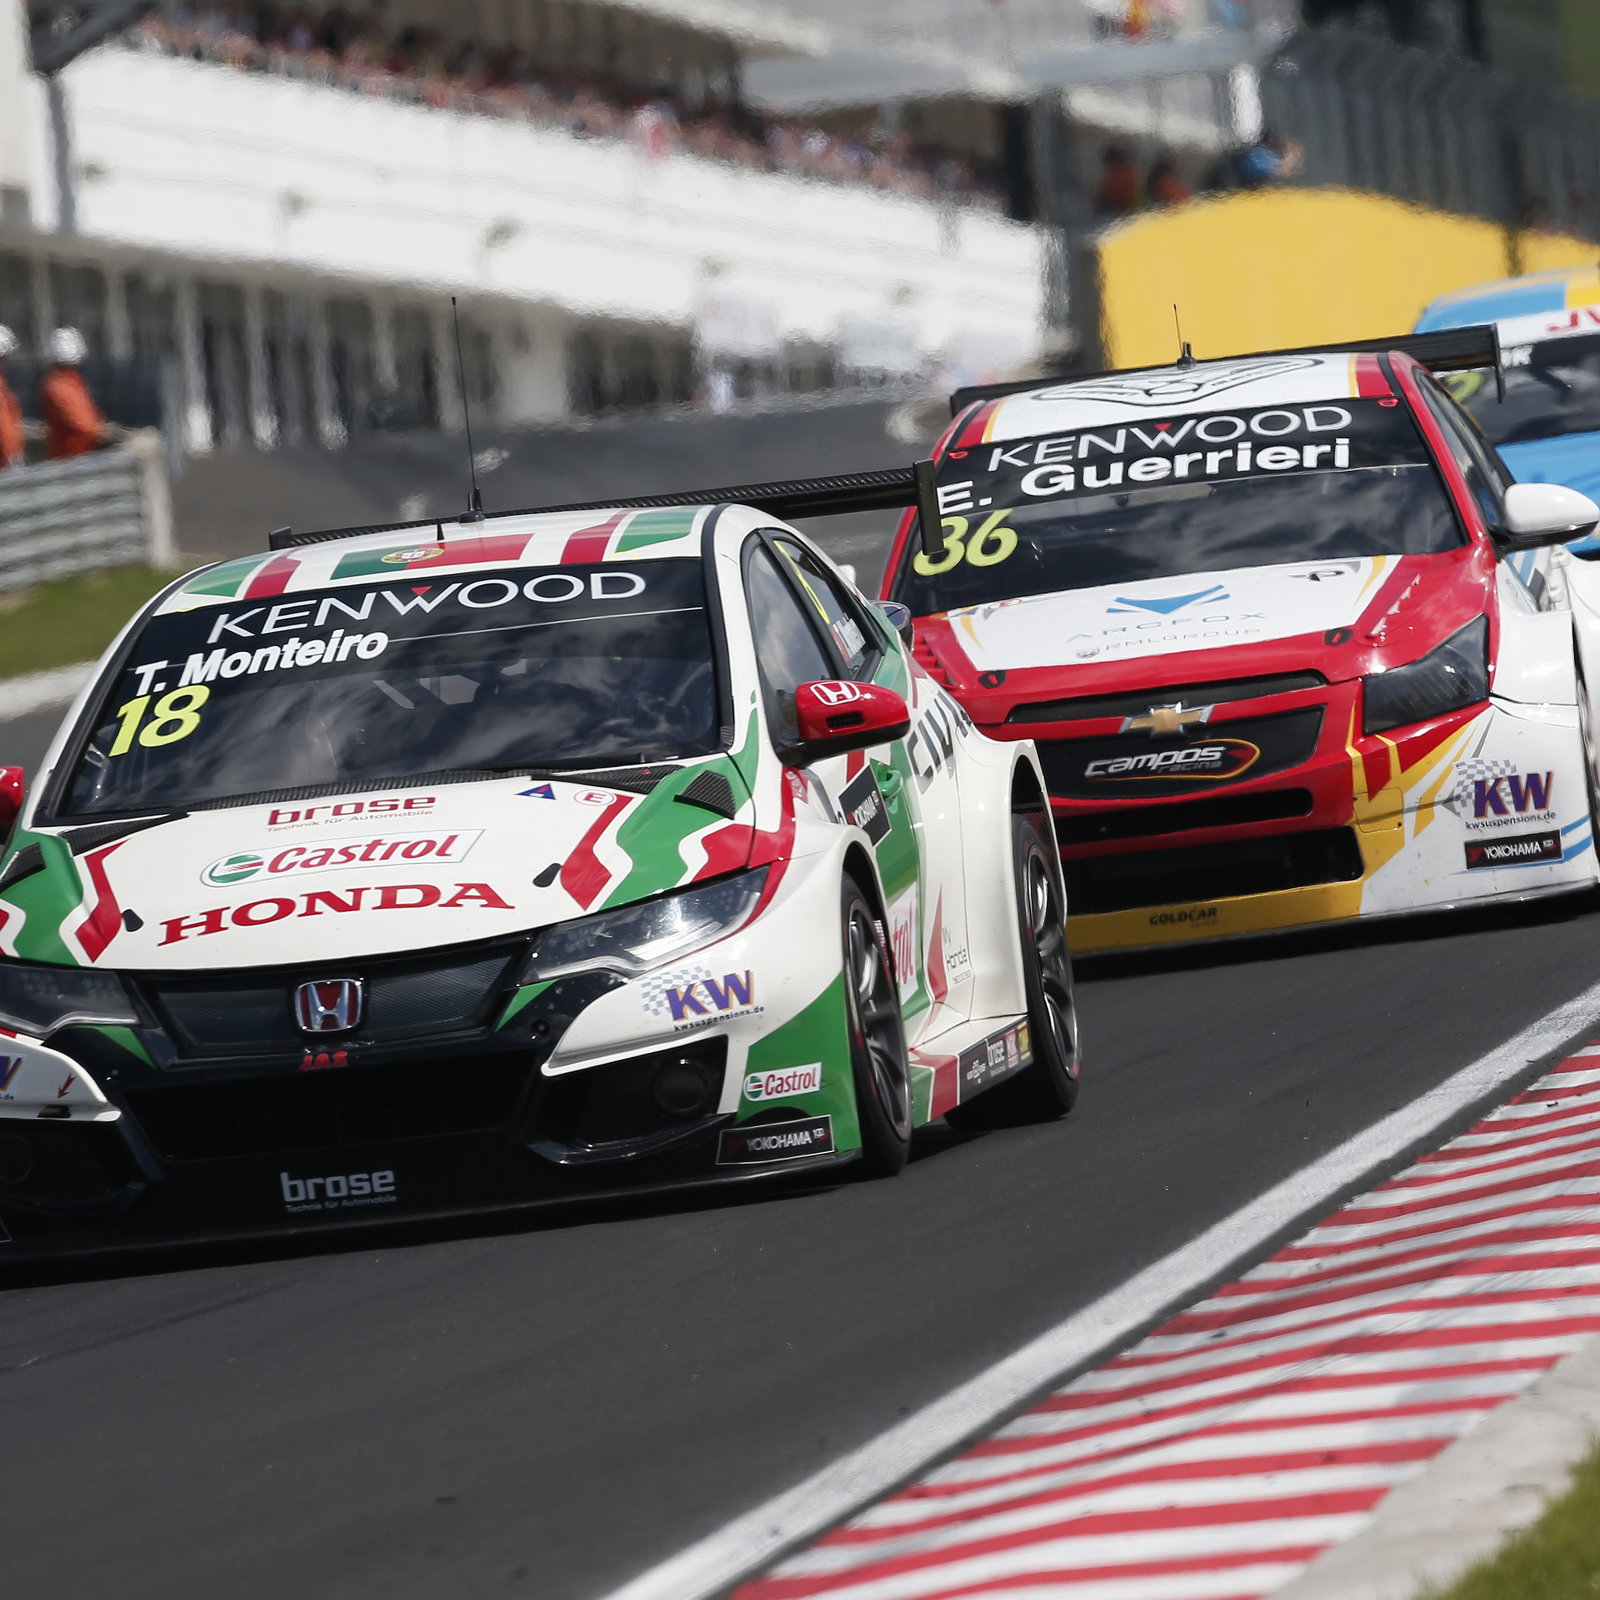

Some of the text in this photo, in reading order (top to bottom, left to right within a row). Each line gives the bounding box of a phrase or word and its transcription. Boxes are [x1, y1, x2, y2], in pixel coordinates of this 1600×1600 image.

[987, 406, 1352, 471] KENWOOD
[937, 438, 1349, 514] E. Guerrieri
[913, 509, 1018, 576] 36
[206, 572, 646, 644] KENWOOD
[135, 629, 389, 697] T. Monteiro
[108, 685, 210, 757] 18
[1084, 746, 1226, 777] campos
[1474, 771, 1553, 819] KW
[267, 797, 436, 825] brose
[350, 809, 433, 821] Automobile
[1465, 810, 1557, 830] kwsuspensions.de
[267, 834, 459, 873] Castrol
[1484, 842, 1541, 859] YOKOHAMA
[157, 883, 515, 947] HONDA
[1149, 907, 1218, 926] GOLDCAR
[666, 970, 754, 1021] KW
[674, 1006, 765, 1032] kwsuspensions.de
[299, 1051, 348, 1071] JAS
[764, 1067, 817, 1096] Castrol
[746, 1131, 812, 1151] YOKOHAMA
[280, 1170, 396, 1202] brose
[341, 1195, 397, 1206] Automobile
